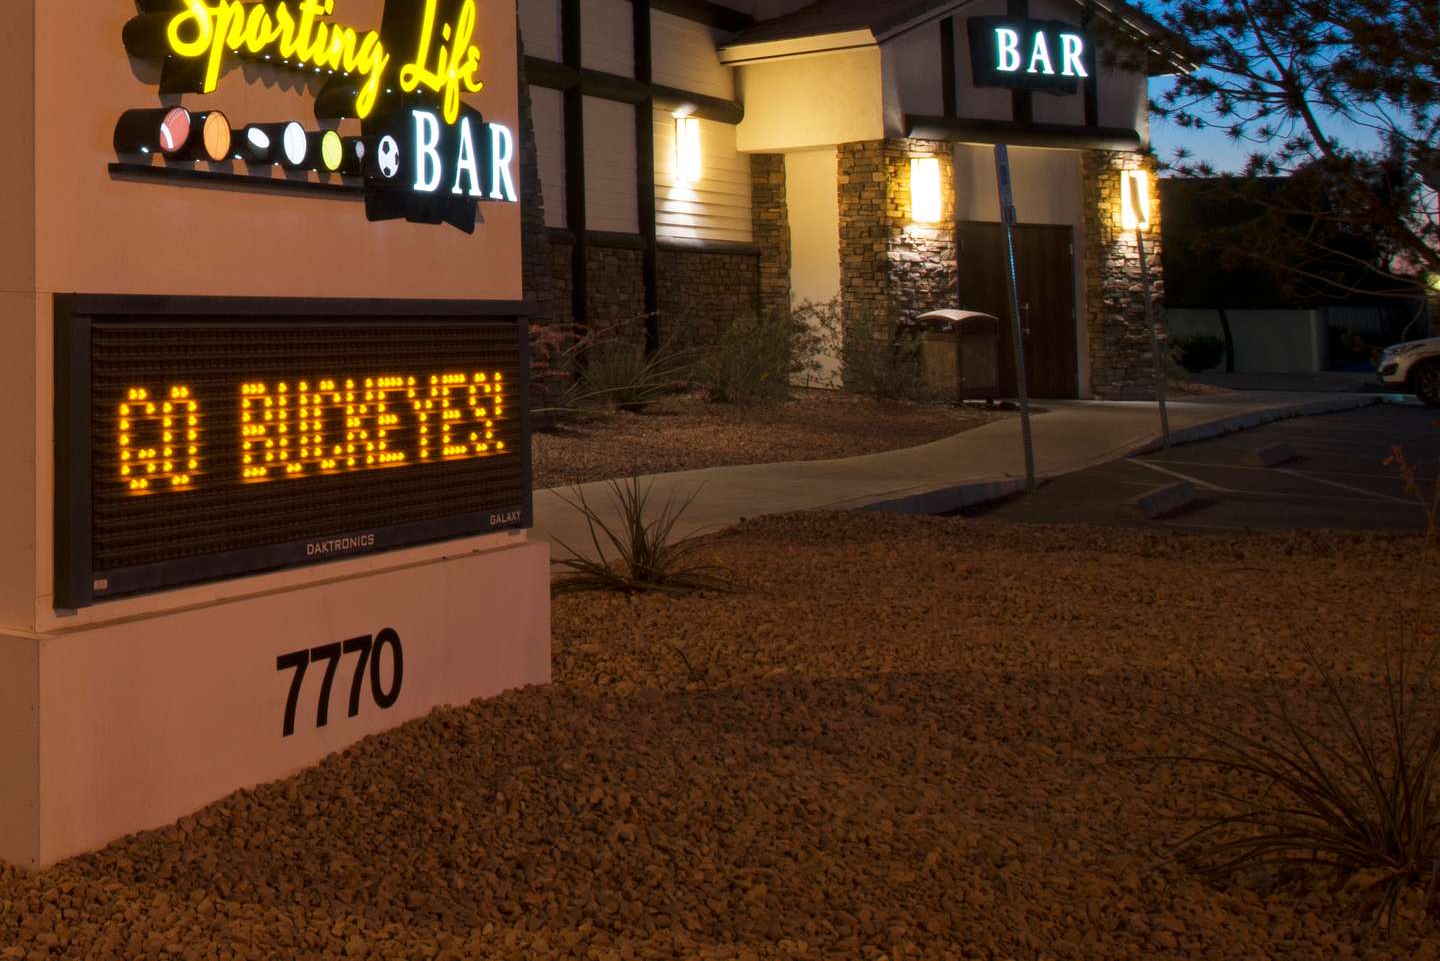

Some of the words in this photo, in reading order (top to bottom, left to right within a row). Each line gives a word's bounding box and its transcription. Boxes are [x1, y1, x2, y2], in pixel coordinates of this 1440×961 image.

[994, 27, 1089, 78] BAR
[412, 108, 519, 203] BAR
[119, 386, 199, 490] GO
[242, 371, 505, 479] BUCKEYES!
[306, 534, 375, 556] DAKTRONICS
[488, 510, 522, 526] GALAXY
[276, 627, 404, 737] 7770
